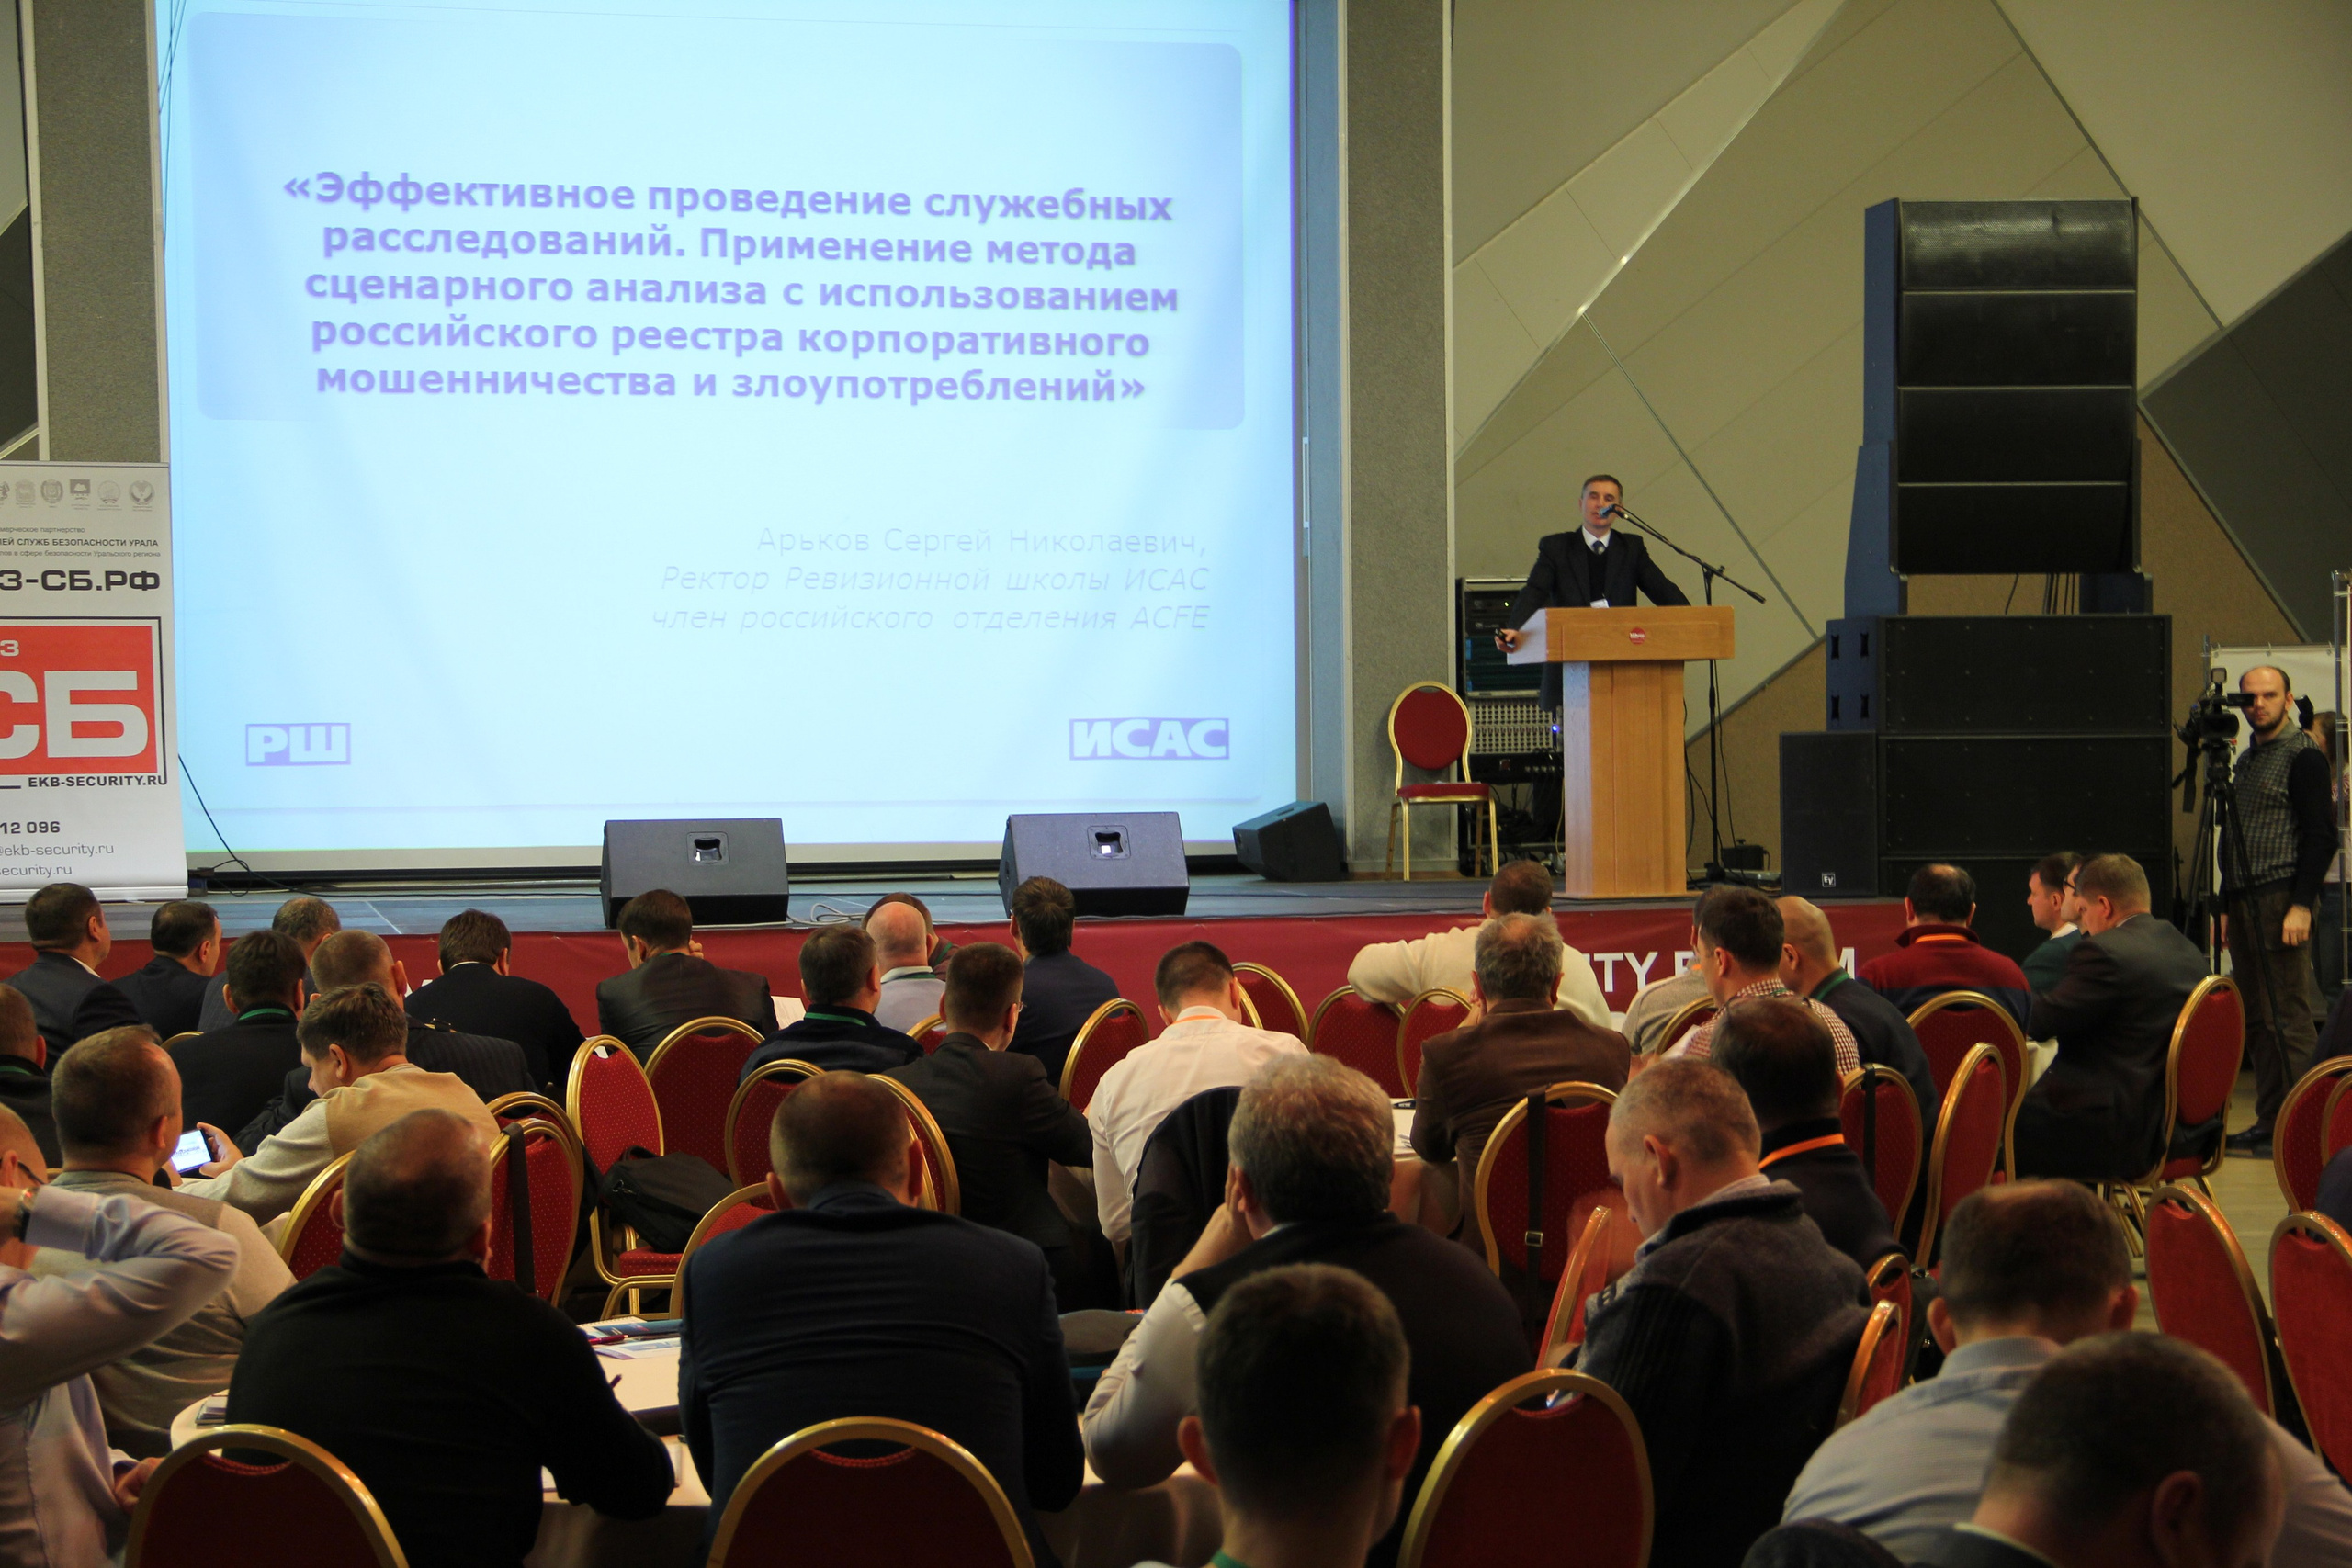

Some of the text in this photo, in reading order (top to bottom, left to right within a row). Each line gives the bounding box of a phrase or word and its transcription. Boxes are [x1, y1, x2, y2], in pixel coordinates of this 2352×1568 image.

[283, 171, 1173, 224] «Эффективное проведение служебных
[322, 223, 1136, 269] расследований. Применение метода
[305, 272, 1178, 312] сценарного анализа с использованием
[311, 313, 1149, 359] российского реестра корпоративного
[317, 367, 1145, 405] мошенничества и злоупотреблений»
[0, 537, 14, 546] ЕЙ
[758, 527, 1206, 557] Арьков Сергей Николаевич,
[662, 566, 1210, 594] Ректор Ревизионной школы ИСАС
[652, 609, 727, 629] член
[739, 605, 933, 634] российского
[953, 609, 1116, 632] отделения
[248, 726, 346, 763] РШ
[1073, 719, 1227, 760] ИСАС
[28, 775, 168, 787] EKB-SECURITY.RU
[27, 821, 61, 833] 096
[0, 864, 73, 878] ecurity.ru
[1581, 951, 1658, 992] TY
